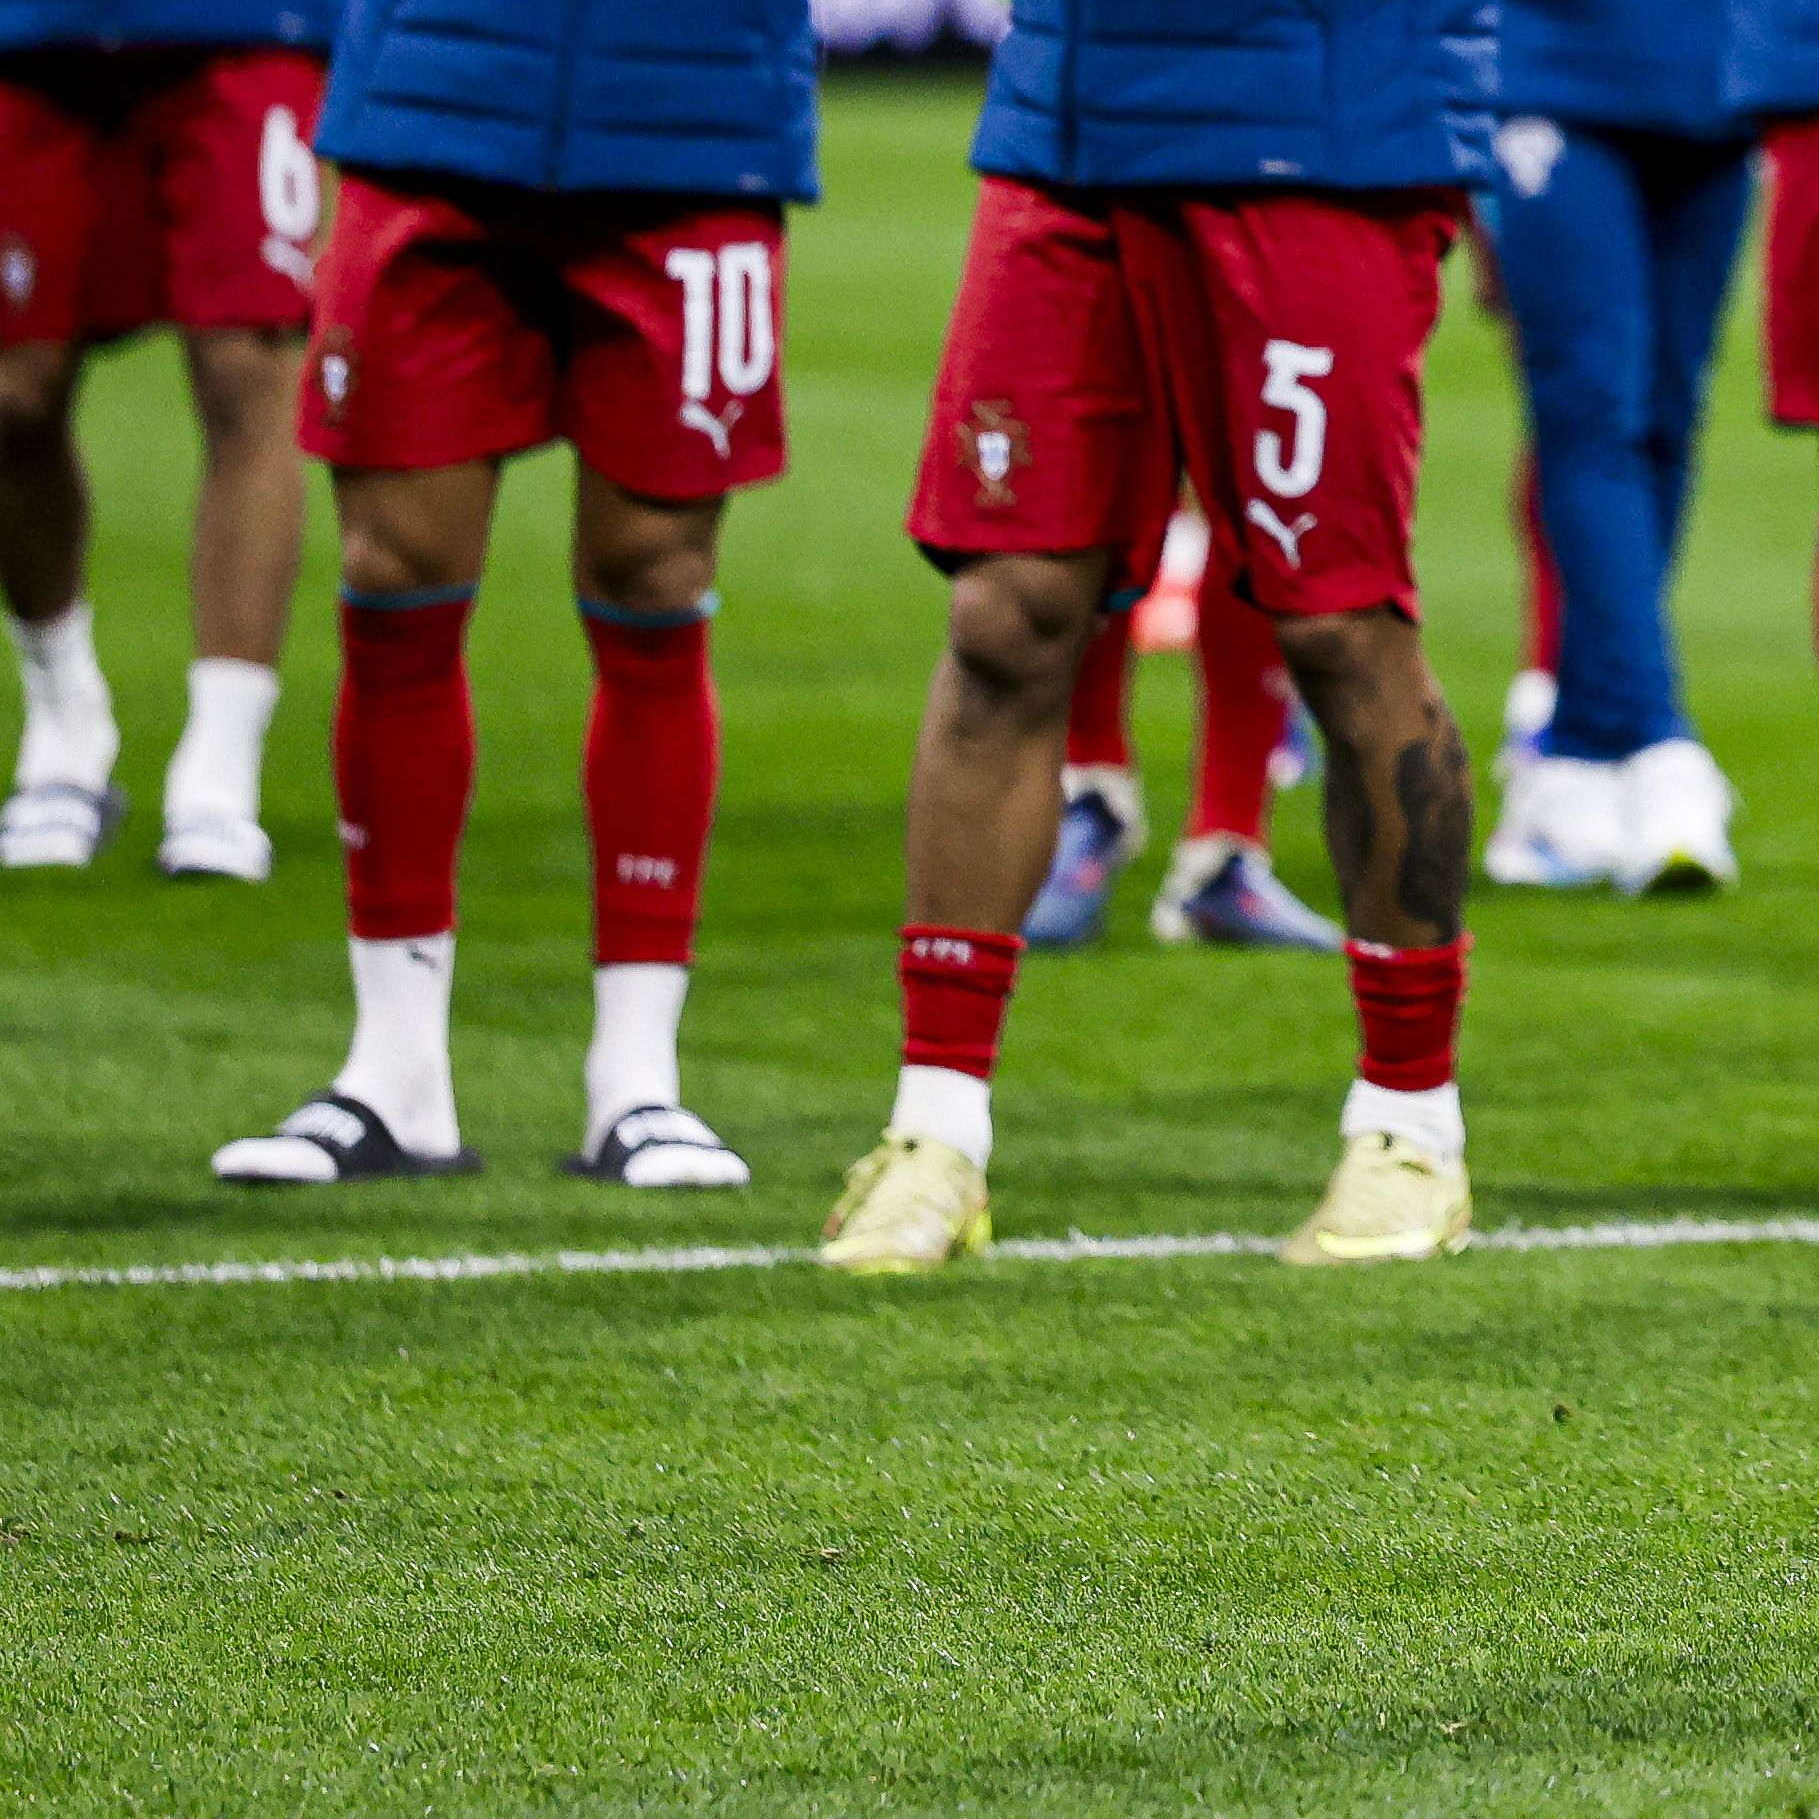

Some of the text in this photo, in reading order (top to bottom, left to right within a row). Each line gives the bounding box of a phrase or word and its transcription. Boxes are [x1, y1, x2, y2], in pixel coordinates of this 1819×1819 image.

[259, 104, 320, 240] 6
[665, 241, 775, 401] 10
[1253, 339, 1333, 498] 5
